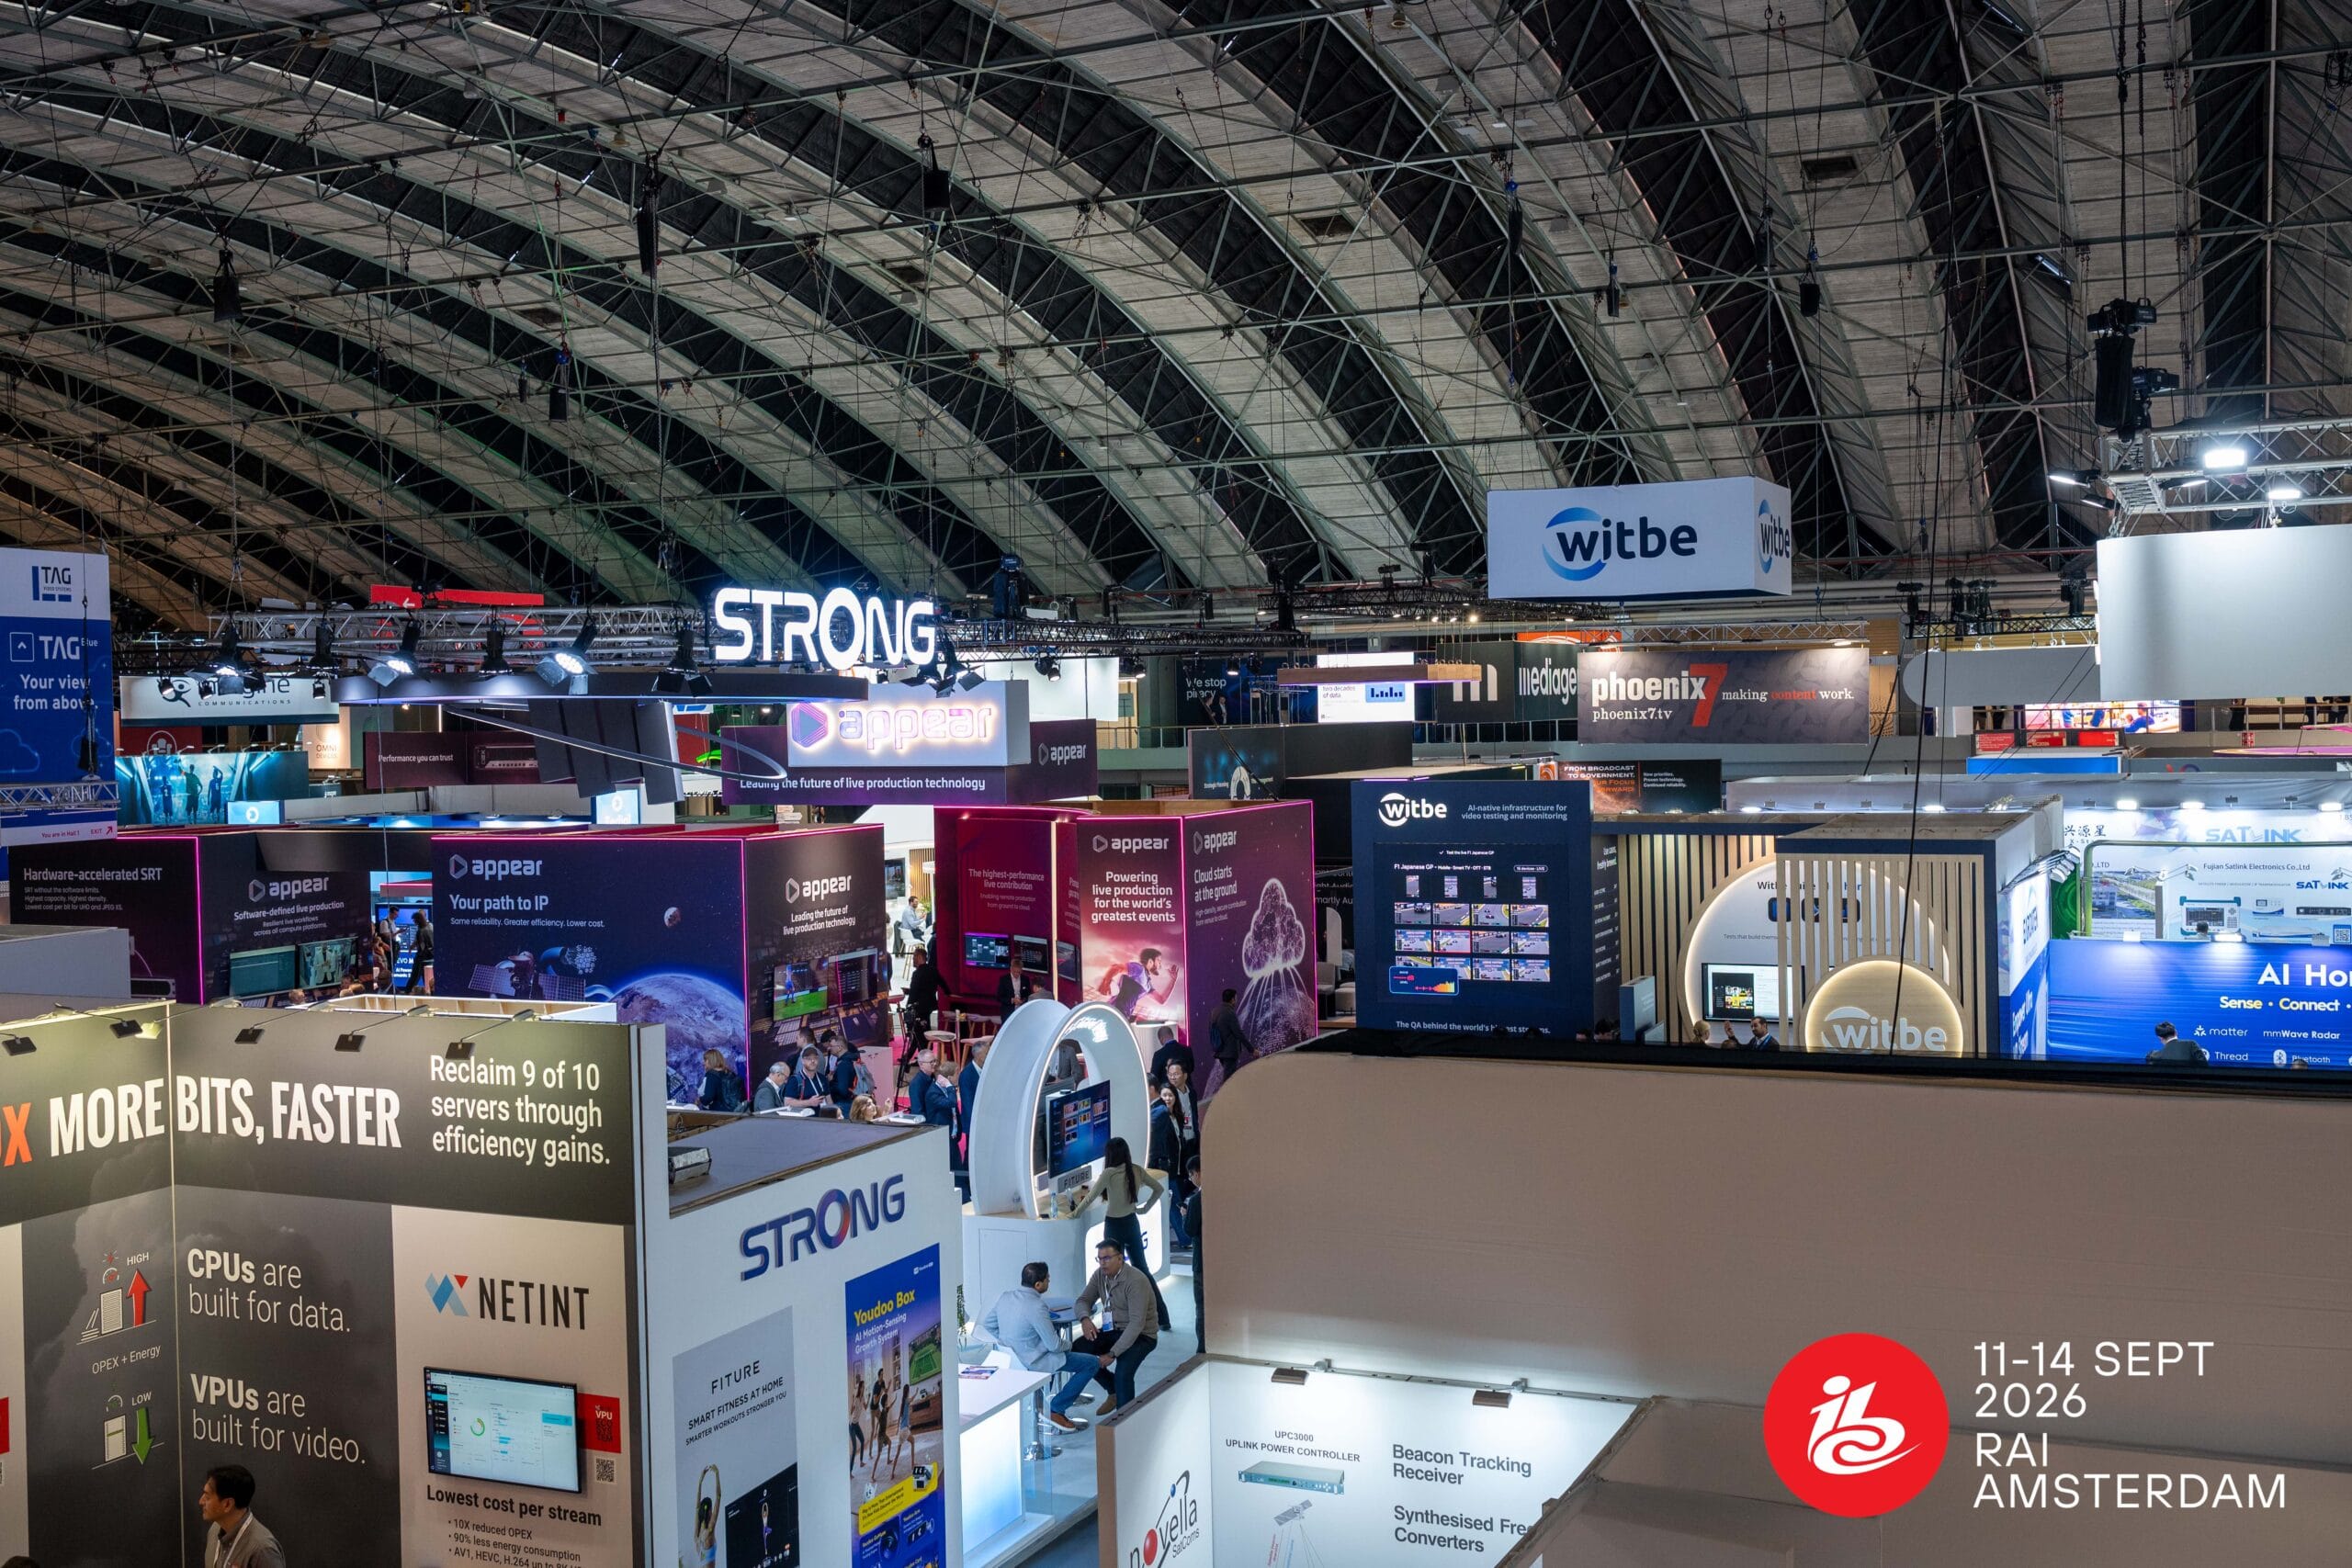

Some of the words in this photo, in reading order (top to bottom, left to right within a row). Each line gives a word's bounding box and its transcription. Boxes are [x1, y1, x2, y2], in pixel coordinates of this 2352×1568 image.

[1556, 516, 1698, 562] witbe
[1760, 514, 1790, 558] witbe
[41, 567, 71, 584] TAG
[714, 587, 937, 670] STRONG
[39, 636, 80, 660] TAG
[20, 674, 53, 689] Your
[59, 675, 91, 689] view
[1519, 657, 1577, 705] mediage
[1722, 690, 1767, 702] making
[1771, 691, 1816, 700] content
[1819, 688, 1854, 699] work.
[1592, 707, 1673, 722] phoenix7.tv
[839, 707, 992, 750] appear
[1050, 744, 1086, 765] appear
[782, 777, 797, 789] the
[800, 777, 831, 789] future
[833, 777, 844, 789] of
[846, 777, 864, 789] live
[866, 777, 922, 791] production
[925, 777, 985, 791] technology
[1385, 798, 1447, 818] witbe
[1484, 813, 1509, 821] testing
[1526, 813, 1567, 821] monitoring
[1112, 838, 1169, 853] appear
[1204, 831, 1237, 853] appear
[24, 868, 138, 881] Hardware-accelerated
[141, 868, 163, 881] SRT
[472, 860, 542, 881] appear
[1106, 872, 1158, 885] Powering
[1194, 870, 1213, 884] Cloud
[1214, 865, 1232, 880] starts
[269, 877, 329, 900] appear
[803, 875, 852, 901] appear
[1092, 885, 1111, 896] live
[1114, 885, 1172, 897] production
[1195, 890, 1204, 903] at
[1204, 887, 1213, 900] the
[1215, 881, 1237, 901] ground
[2296, 880, 2349, 889] SATLINK
[234, 906, 295, 920] Software-defined
[310, 901, 344, 913] production
[449, 895, 481, 910] Your
[484, 896, 514, 913] path
[517, 897, 531, 910] to
[535, 896, 548, 910] IP
[1094, 897, 1110, 908] for
[1112, 897, 1130, 908] the
[1132, 897, 1171, 908] world's
[1091, 911, 1136, 924] greatest
[1139, 912, 1175, 921] events
[2257, 963, 2290, 986] AI
[2305, 964, 2352, 987] Ho
[2220, 996, 2263, 1010] Sense
[2278, 998, 2340, 1011] Connect
[1832, 1015, 1947, 1051] witbe
[2210, 1027, 2248, 1037] matter
[2264, 1030, 2309, 1039] mmWave
[2312, 1031, 2340, 1039] Radar
[2214, 1051, 2248, 1061] Thread
[430, 1055, 515, 1086] Reclaim
[522, 1059, 536, 1087] 9
[542, 1060, 566, 1089] of
[572, 1063, 600, 1091] 10
[49, 1077, 164, 1157] MORE
[176, 1075, 266, 1145] BITS,
[271, 1080, 402, 1148] FASTER
[431, 1095, 510, 1122] servers
[515, 1094, 603, 1134] through
[432, 1124, 537, 1166] efficiency
[543, 1134, 610, 1168] gains.
[1064, 1170, 1089, 1189] FITURE
[740, 1174, 905, 1281] STRONG
[127, 1252, 150, 1266] HIGH
[187, 1247, 255, 1284] CPUs
[263, 1263, 302, 1289] are
[189, 1283, 240, 1319] built
[247, 1290, 281, 1324] for
[289, 1295, 351, 1332] data.
[479, 1277, 589, 1330] NETINT
[854, 1300, 894, 1326] Youdoo
[896, 1290, 915, 1308] Box
[854, 1332, 861, 1343] AI
[864, 1313, 907, 1338] Motion-Sensing
[855, 1337, 876, 1354] Growth
[877, 1329, 898, 1344] System
[92, 1356, 119, 1374] OPEX
[130, 1346, 161, 1364] Energy
[712, 1360, 761, 1394] FITURE
[131, 1391, 152, 1406] LOW
[190, 1373, 259, 1411] VPUs
[266, 1391, 306, 1416] are
[688, 1409, 715, 1429] SMART
[718, 1393, 748, 1416] FITNESS
[751, 1388, 760, 1400] AT
[762, 1377, 784, 1394] HOME
[595, 1410, 612, 1420] VPU
[685, 1427, 712, 1446] SMARTER
[714, 1411, 745, 1432] WORKOUTS
[746, 1396, 775, 1416] STRONGER
[775, 1391, 786, 1401] YOU
[193, 1408, 243, 1447] built
[251, 1416, 285, 1451] for
[291, 1426, 366, 1464] video.
[1274, 1430, 1314, 1442] UPC3000
[1226, 1438, 1259, 1450] UPLINK
[1261, 1442, 1295, 1454] POWER
[1297, 1447, 1361, 1462] CONTROLLER
[1393, 1444, 1453, 1465] Beacon
[1459, 1451, 1532, 1478] Tracking
[1393, 1462, 1464, 1484] Receiver
[426, 1484, 480, 1507] Lowest
[483, 1496, 514, 1513] cost
[519, 1502, 544, 1518] per
[548, 1506, 602, 1527] stream
[454, 1518, 470, 1529] 10X
[472, 1522, 506, 1536] reduced
[508, 1528, 533, 1540] OPEX
[1394, 1506, 1494, 1532] Synthesised
[454, 1533, 471, 1544] 90%
[473, 1536, 491, 1548] less
[492, 1540, 522, 1554] energy
[524, 1545, 581, 1562] consumption
[1172, 1528, 1200, 1558] SatComs
[1395, 1527, 1484, 1552] Converters
